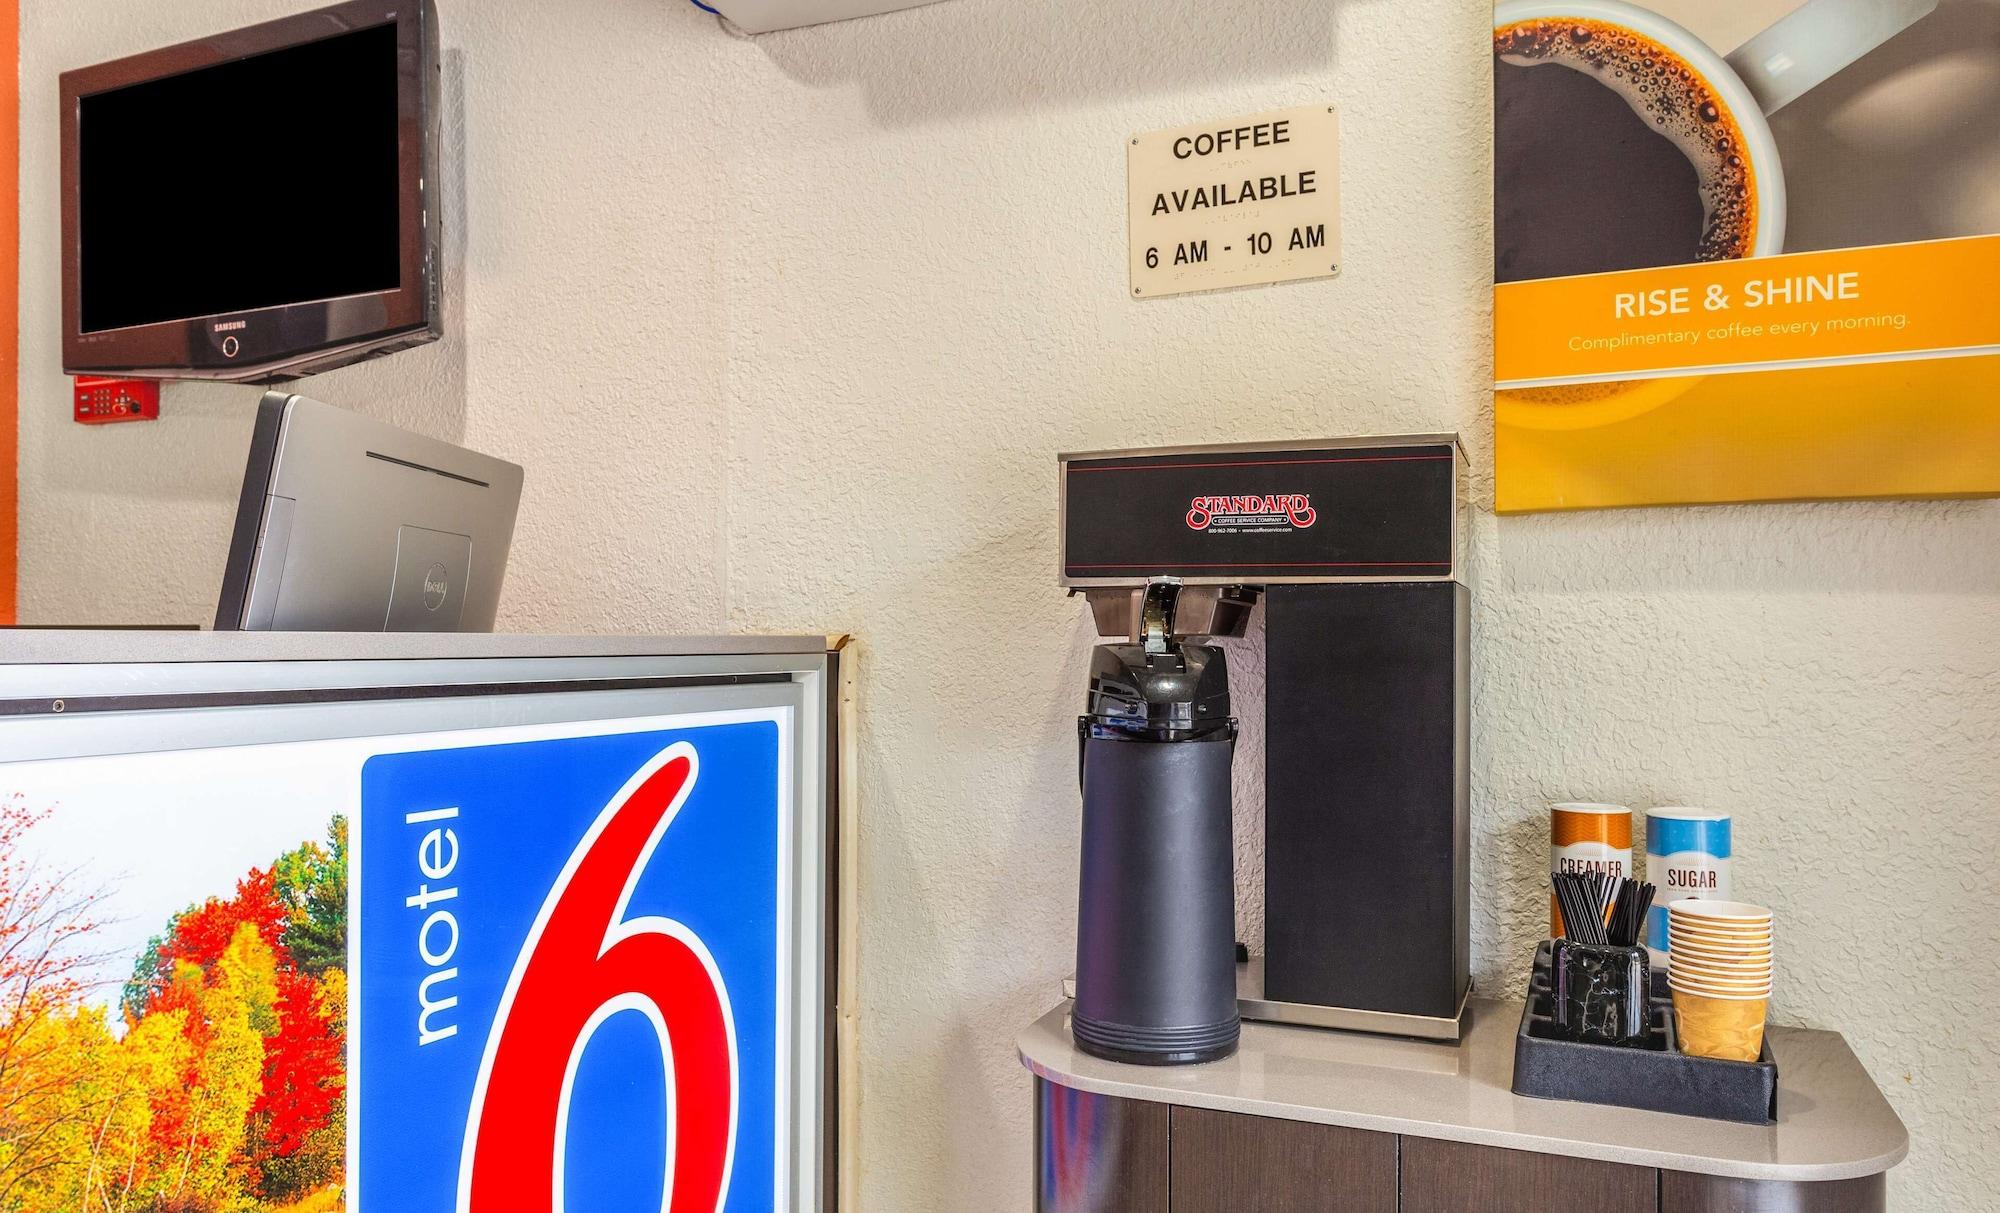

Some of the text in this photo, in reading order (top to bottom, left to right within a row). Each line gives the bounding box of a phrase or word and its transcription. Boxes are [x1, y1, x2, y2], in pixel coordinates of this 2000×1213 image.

[1172, 120, 1290, 159] COFFEE
[1151, 170, 1316, 216] AVAILABLE
[1145, 247, 1159, 269] 6
[1173, 240, 1208, 265] AM
[1247, 232, 1272, 255] 10
[1288, 224, 1325, 250] AM
[1614, 272, 1860, 319] RISE & SHINE
[214, 320, 246, 332] SAMSUNG
[1568, 312, 1911, 352] Complimentary coffee every morning.
[1186, 494, 1317, 530] STANDARD
[1668, 869, 1717, 888] SUGAR
[405, 807, 459, 1047] motel
[455, 741, 740, 1213] 6
